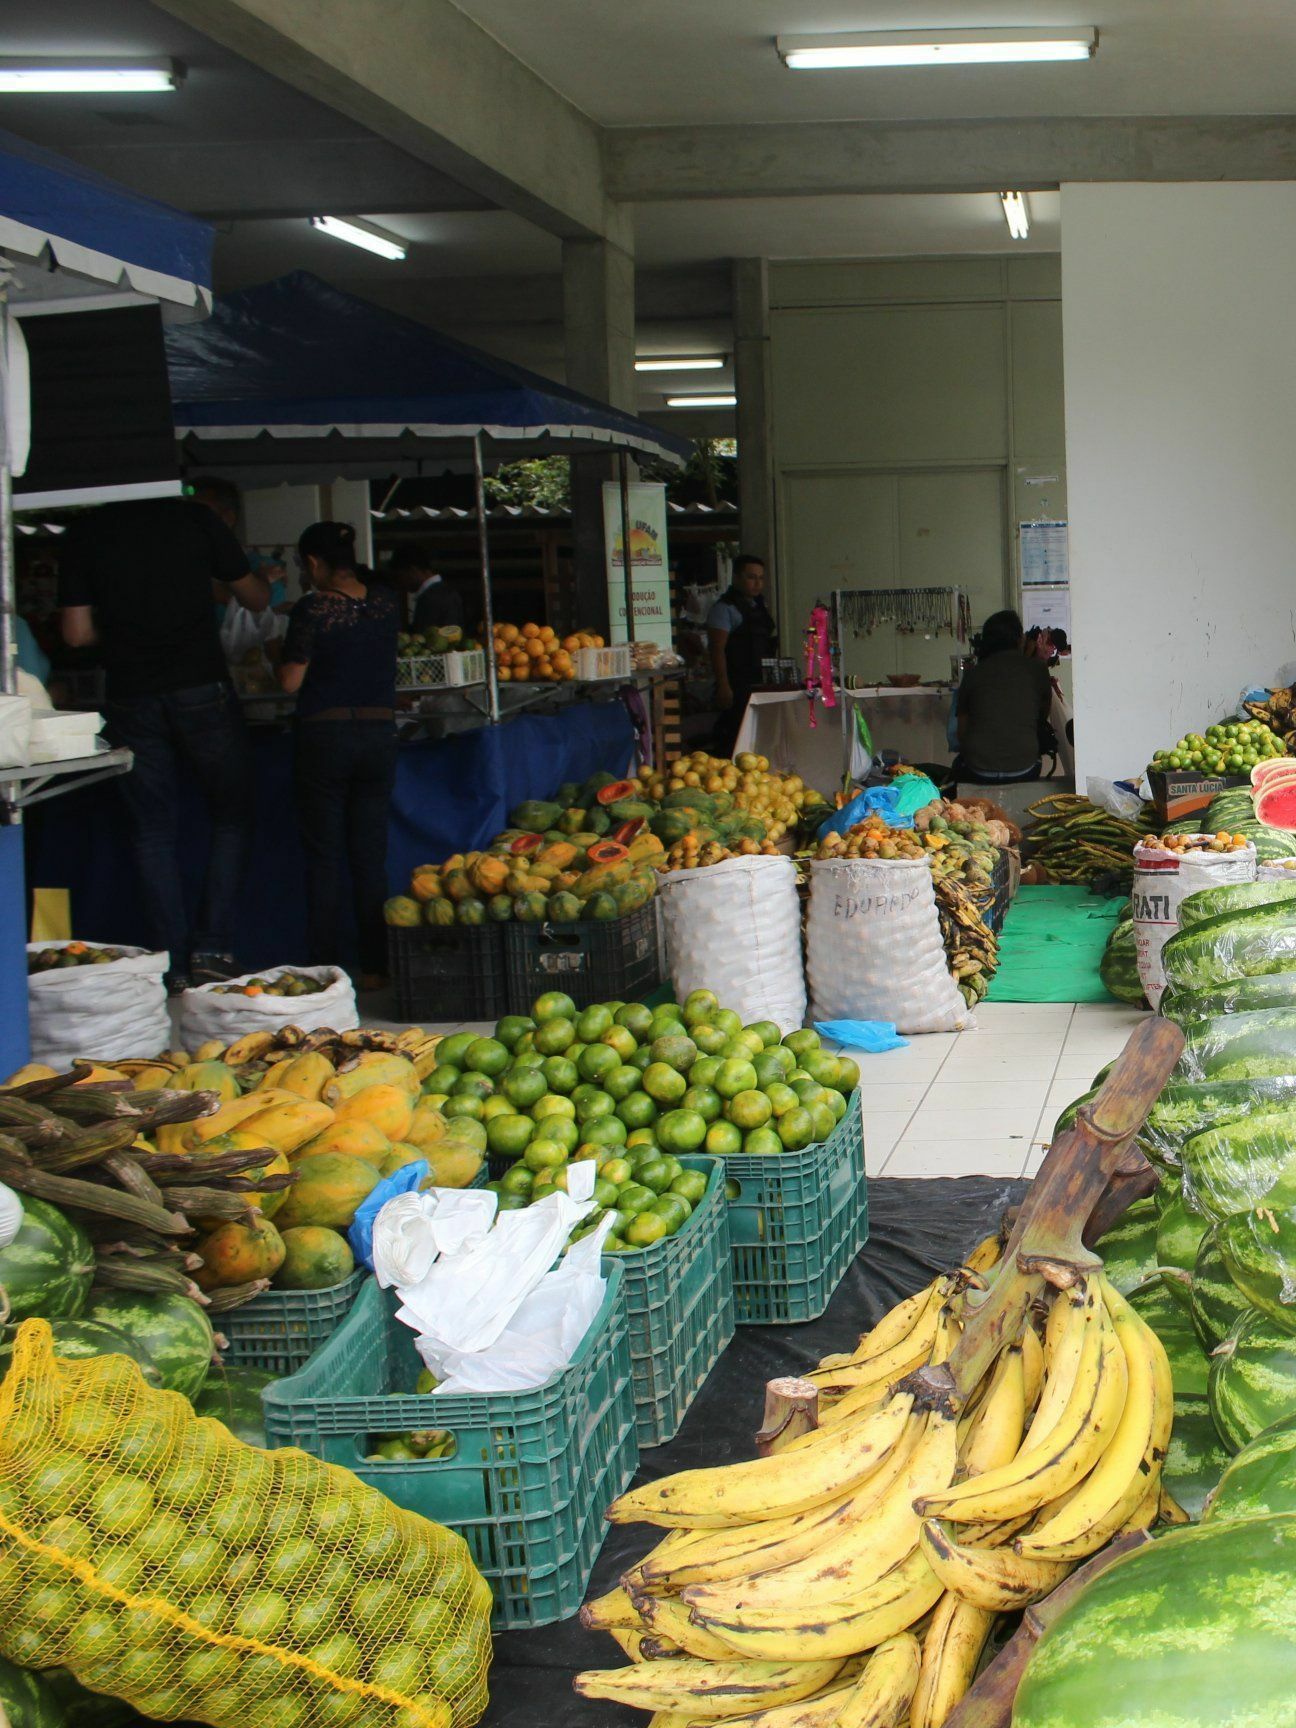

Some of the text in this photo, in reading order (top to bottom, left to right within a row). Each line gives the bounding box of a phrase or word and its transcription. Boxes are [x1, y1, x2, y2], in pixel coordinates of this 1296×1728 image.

[635, 520, 659, 541] UFAM
[632, 589, 656, 602] ODUÇÃO
[619, 605, 663, 617] COENCIONAL
[1170, 784, 1197, 795] SANTA
[834, 887, 920, 919] EDUARDO
